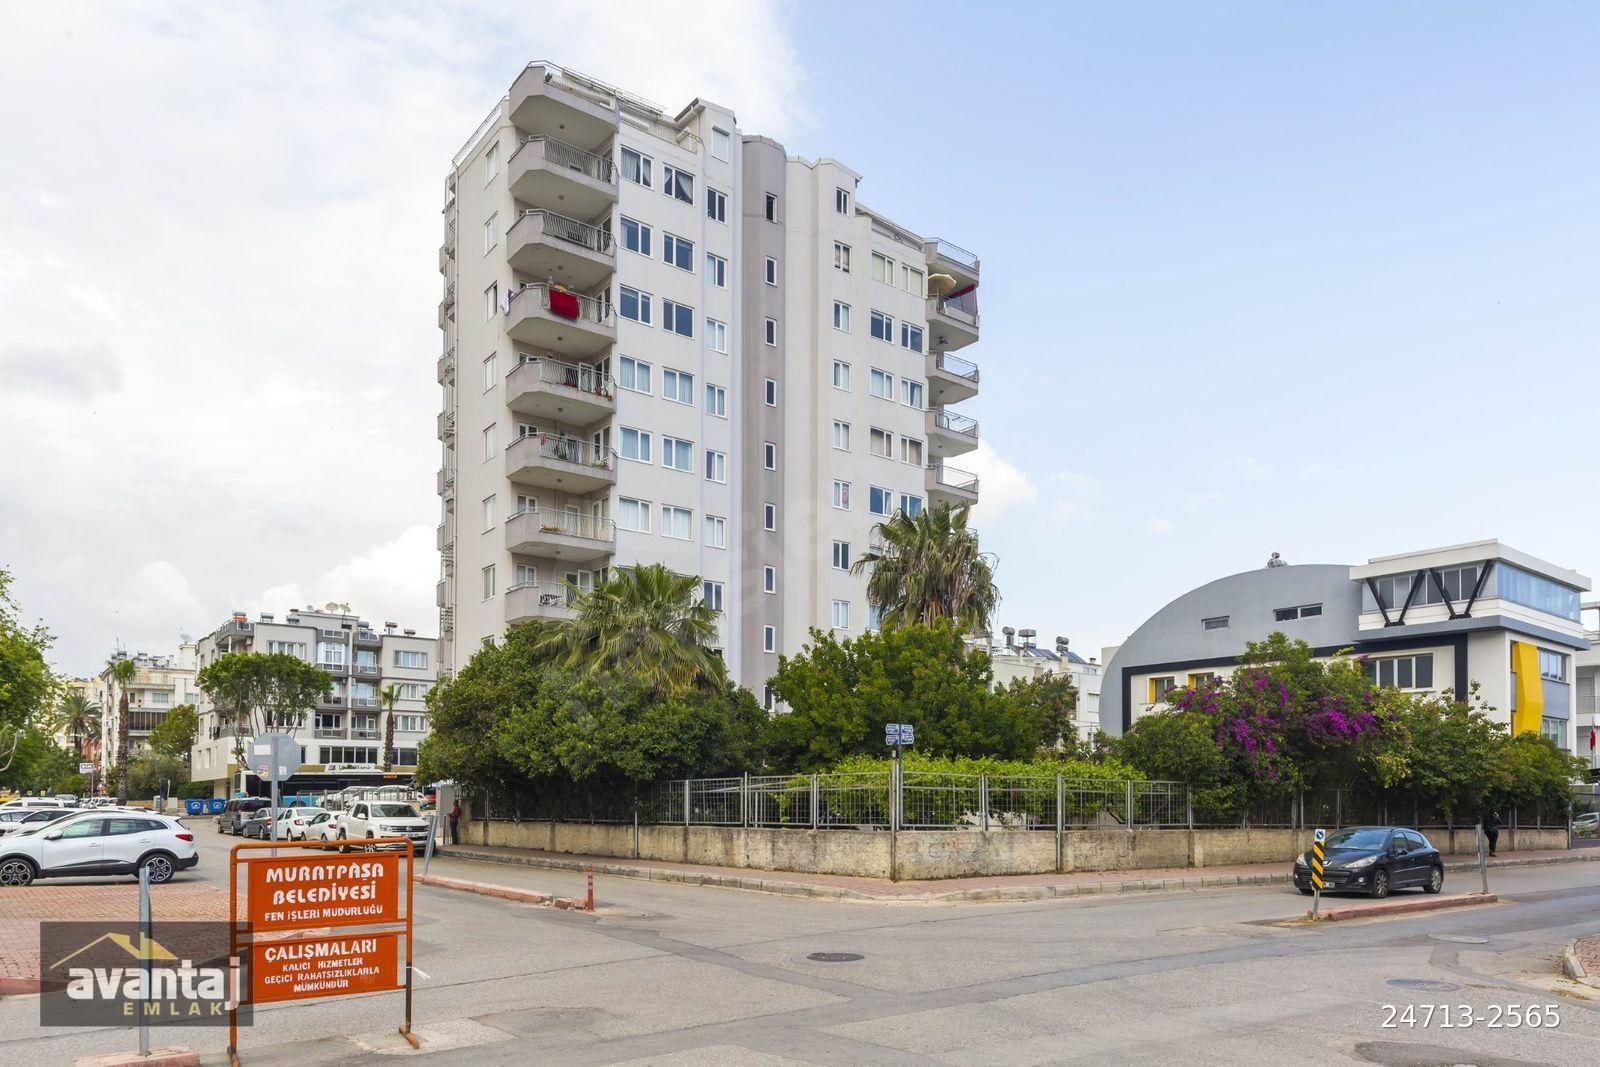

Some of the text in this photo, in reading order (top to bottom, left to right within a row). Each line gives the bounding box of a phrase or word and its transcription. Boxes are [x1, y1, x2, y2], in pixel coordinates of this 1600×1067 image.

[265, 862, 384, 883] MURATPAŞA
[272, 881, 376, 905] BELEDİYESİ
[264, 911, 284, 922] FEN
[264, 938, 377, 963] ÇALIŞMALARI
[297, 966, 380, 982] RAHATSIZLIKLARLA
